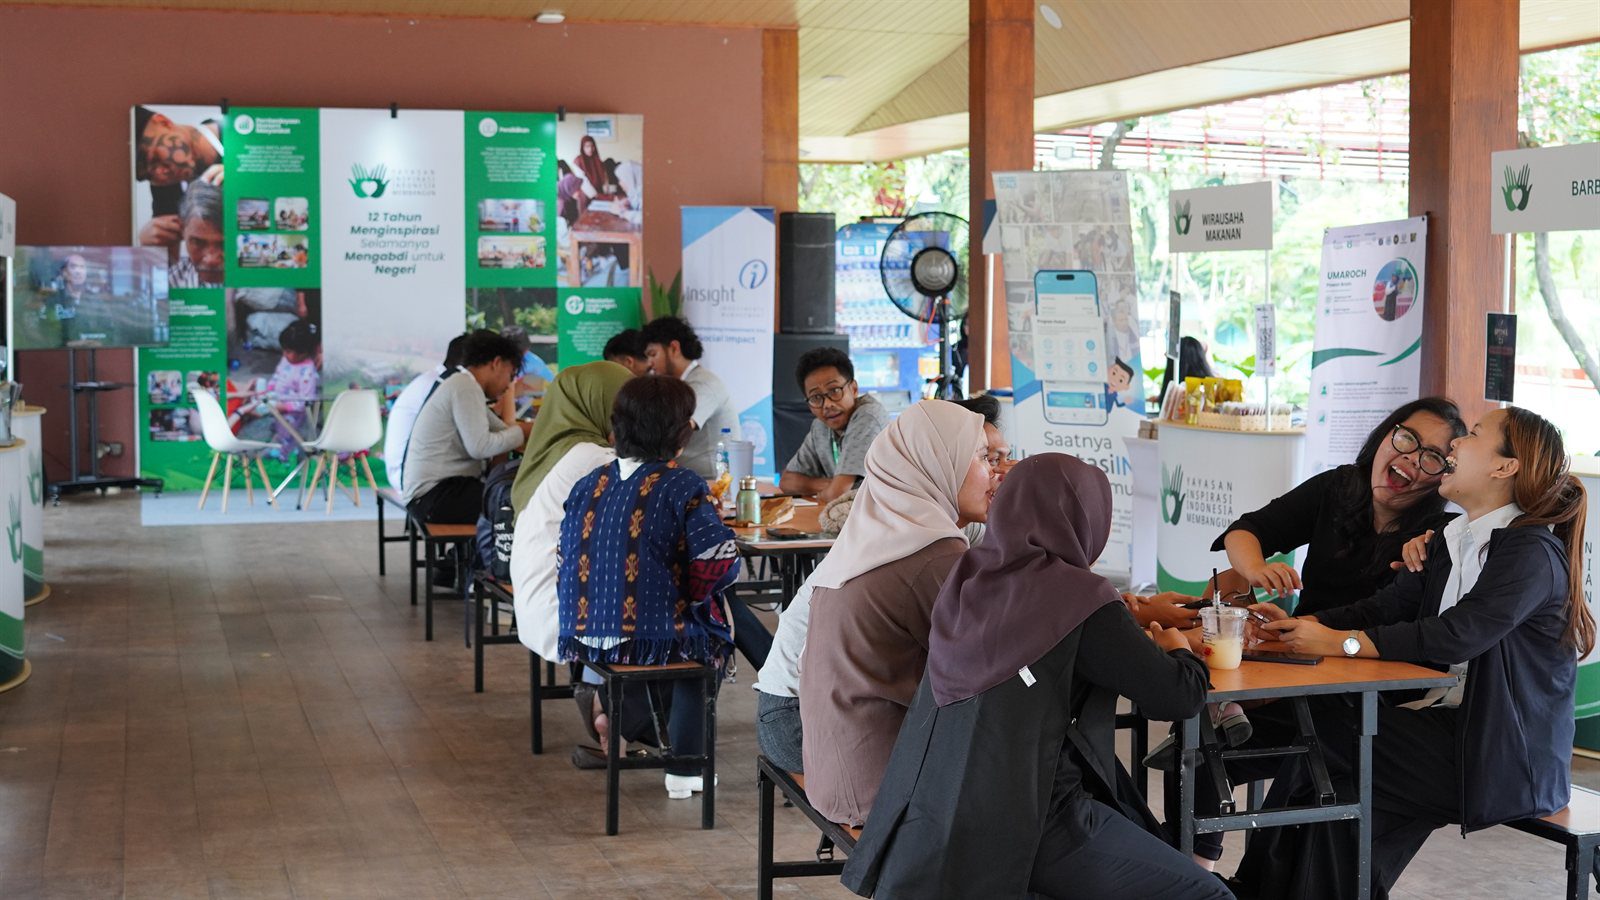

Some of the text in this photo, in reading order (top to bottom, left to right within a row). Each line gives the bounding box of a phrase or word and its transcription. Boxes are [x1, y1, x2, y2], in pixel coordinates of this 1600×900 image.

[1571, 178, 1600, 197] BARB
[368, 212, 422, 222] 12 Tahun
[1201, 211, 1245, 226] WIRAUSAHA
[350, 224, 440, 238] Menginspirasi
[1205, 227, 1242, 242] MAKANAN
[360, 239, 430, 250] Selamanya
[344, 251, 446, 264] Mengabdi untuk
[374, 264, 417, 277] Negeri
[1327, 268, 1367, 280] UMAROCH
[1043, 430, 1113, 453] Saatnya
[1186, 476, 1233, 491] YAYASAN
[1186, 489, 1233, 505] INSPIRASI
[1186, 501, 1233, 516] INDONESIA
